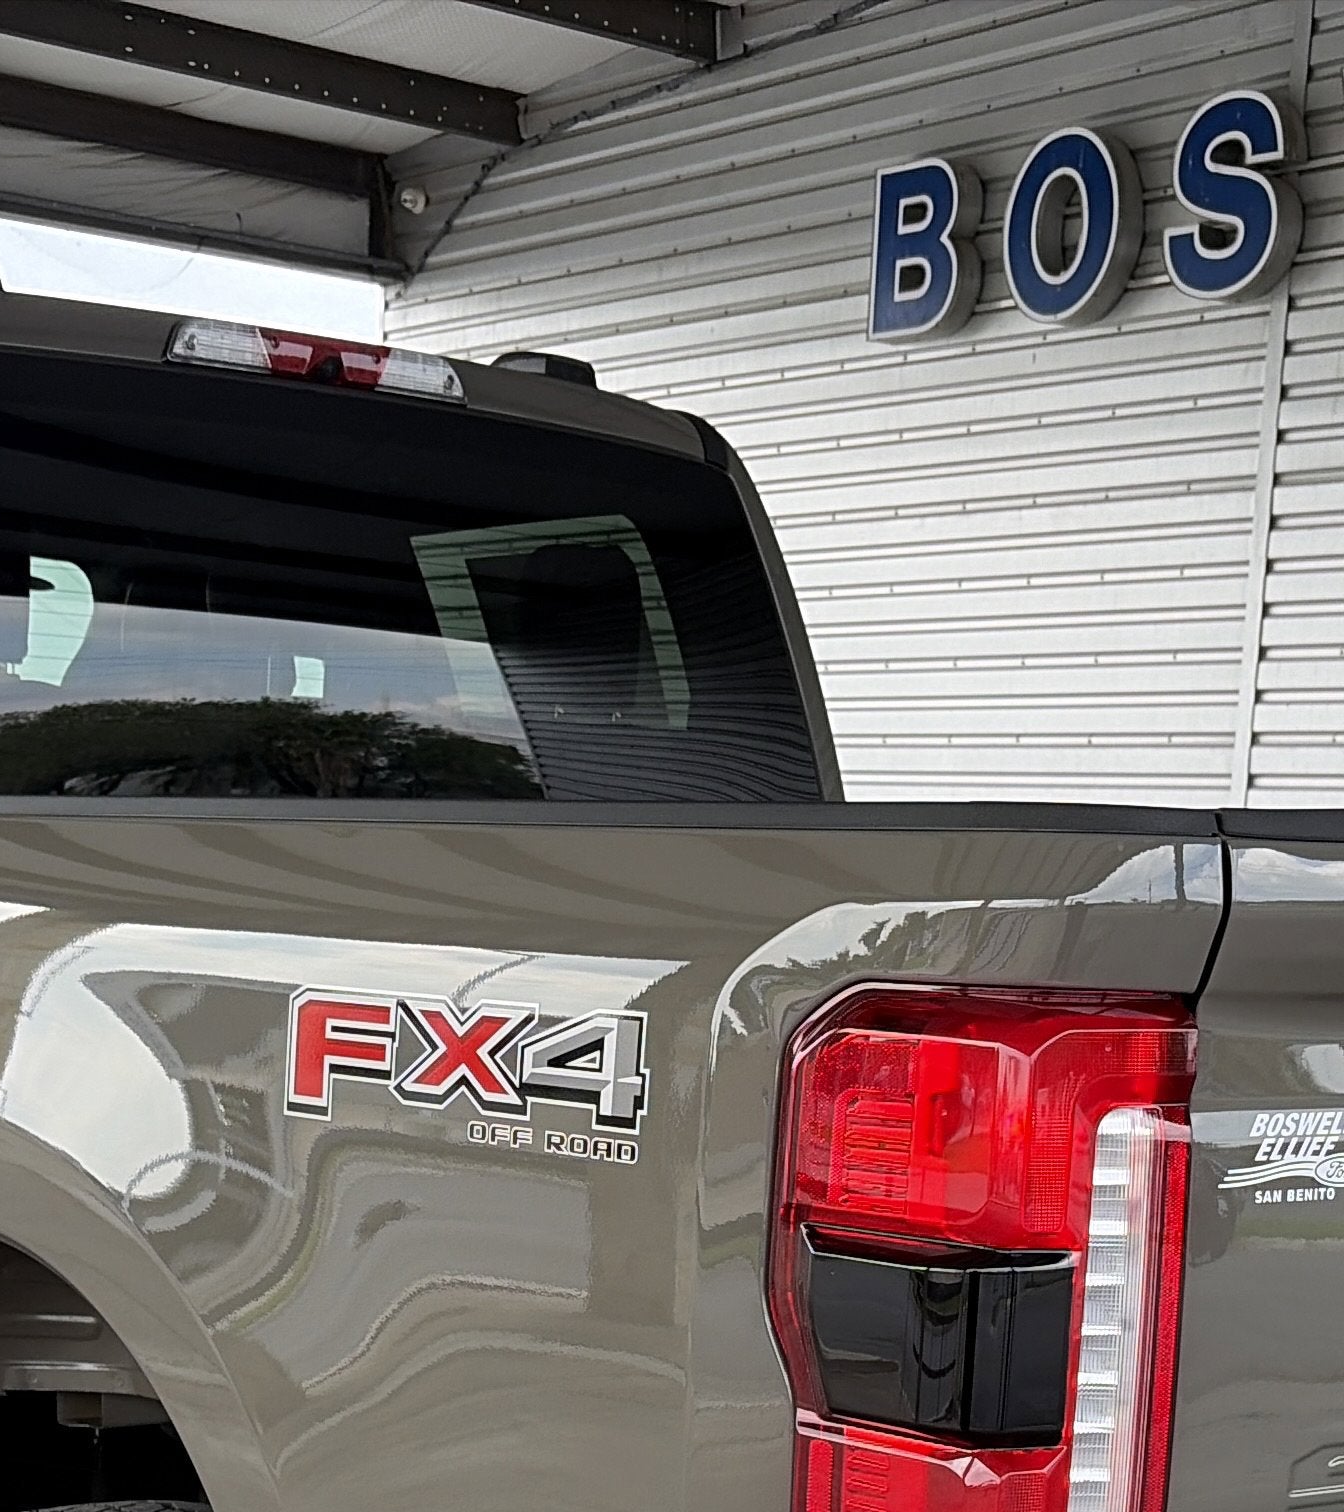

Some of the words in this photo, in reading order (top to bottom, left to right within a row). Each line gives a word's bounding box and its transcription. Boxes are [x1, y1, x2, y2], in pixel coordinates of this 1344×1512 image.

[284, 984, 650, 1136] FX4
[467, 1121, 534, 1149] OFF
[544, 1130, 638, 1164] ROAD
[1254, 1189, 1282, 1204] SAN
[1286, 1187, 1336, 1202] BENITO
